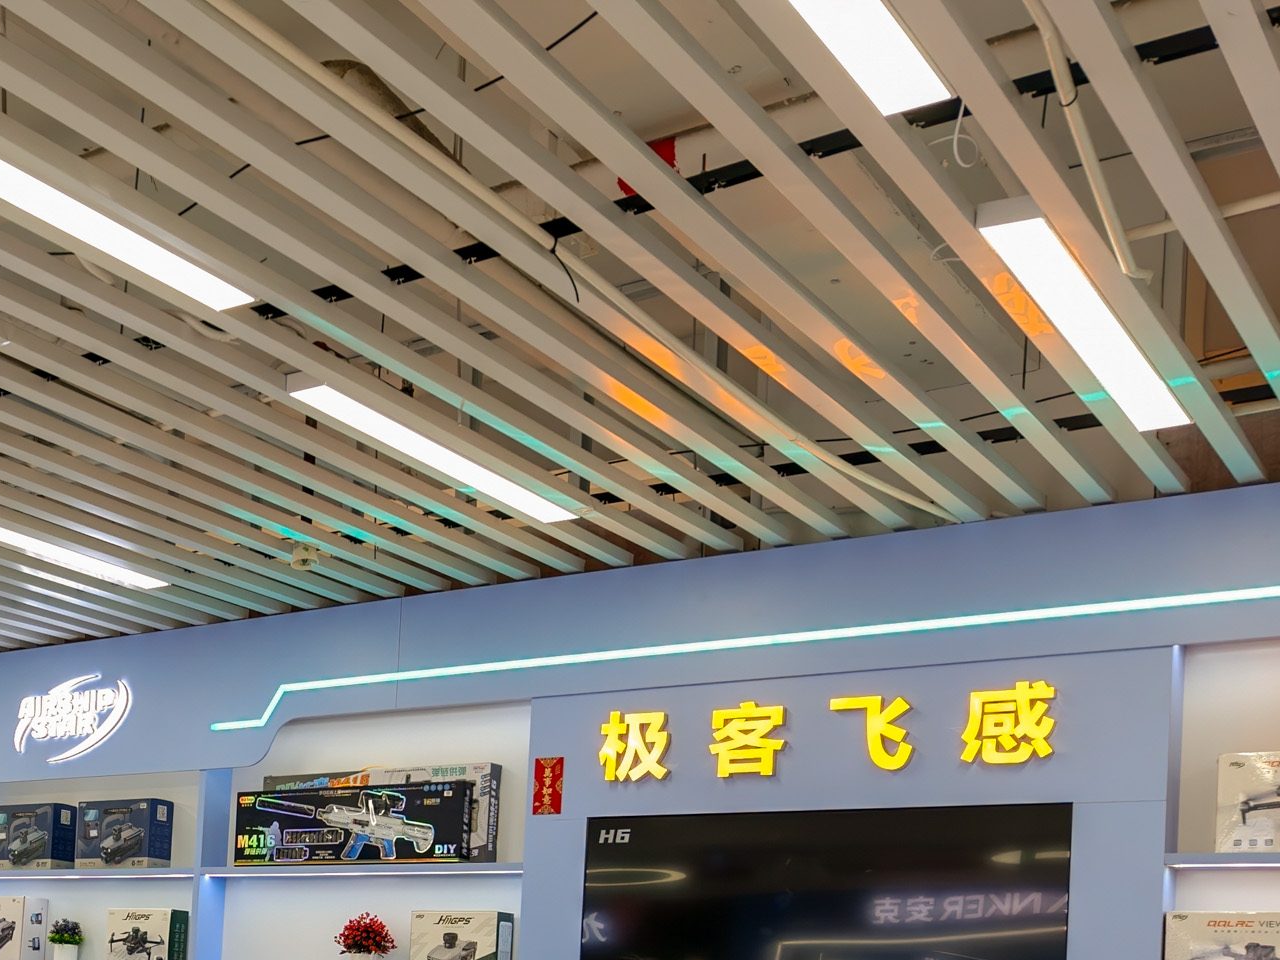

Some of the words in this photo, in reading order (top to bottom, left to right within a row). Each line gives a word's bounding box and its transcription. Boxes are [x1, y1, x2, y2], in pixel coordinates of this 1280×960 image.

[18, 688, 118, 719] AIRSHIP
[31, 714, 98, 740] STAR
[599, 680, 1055, 782] 极客飞感
[237, 834, 276, 848] M416
[598, 828, 631, 844] H6
[434, 844, 457, 854] DIY
